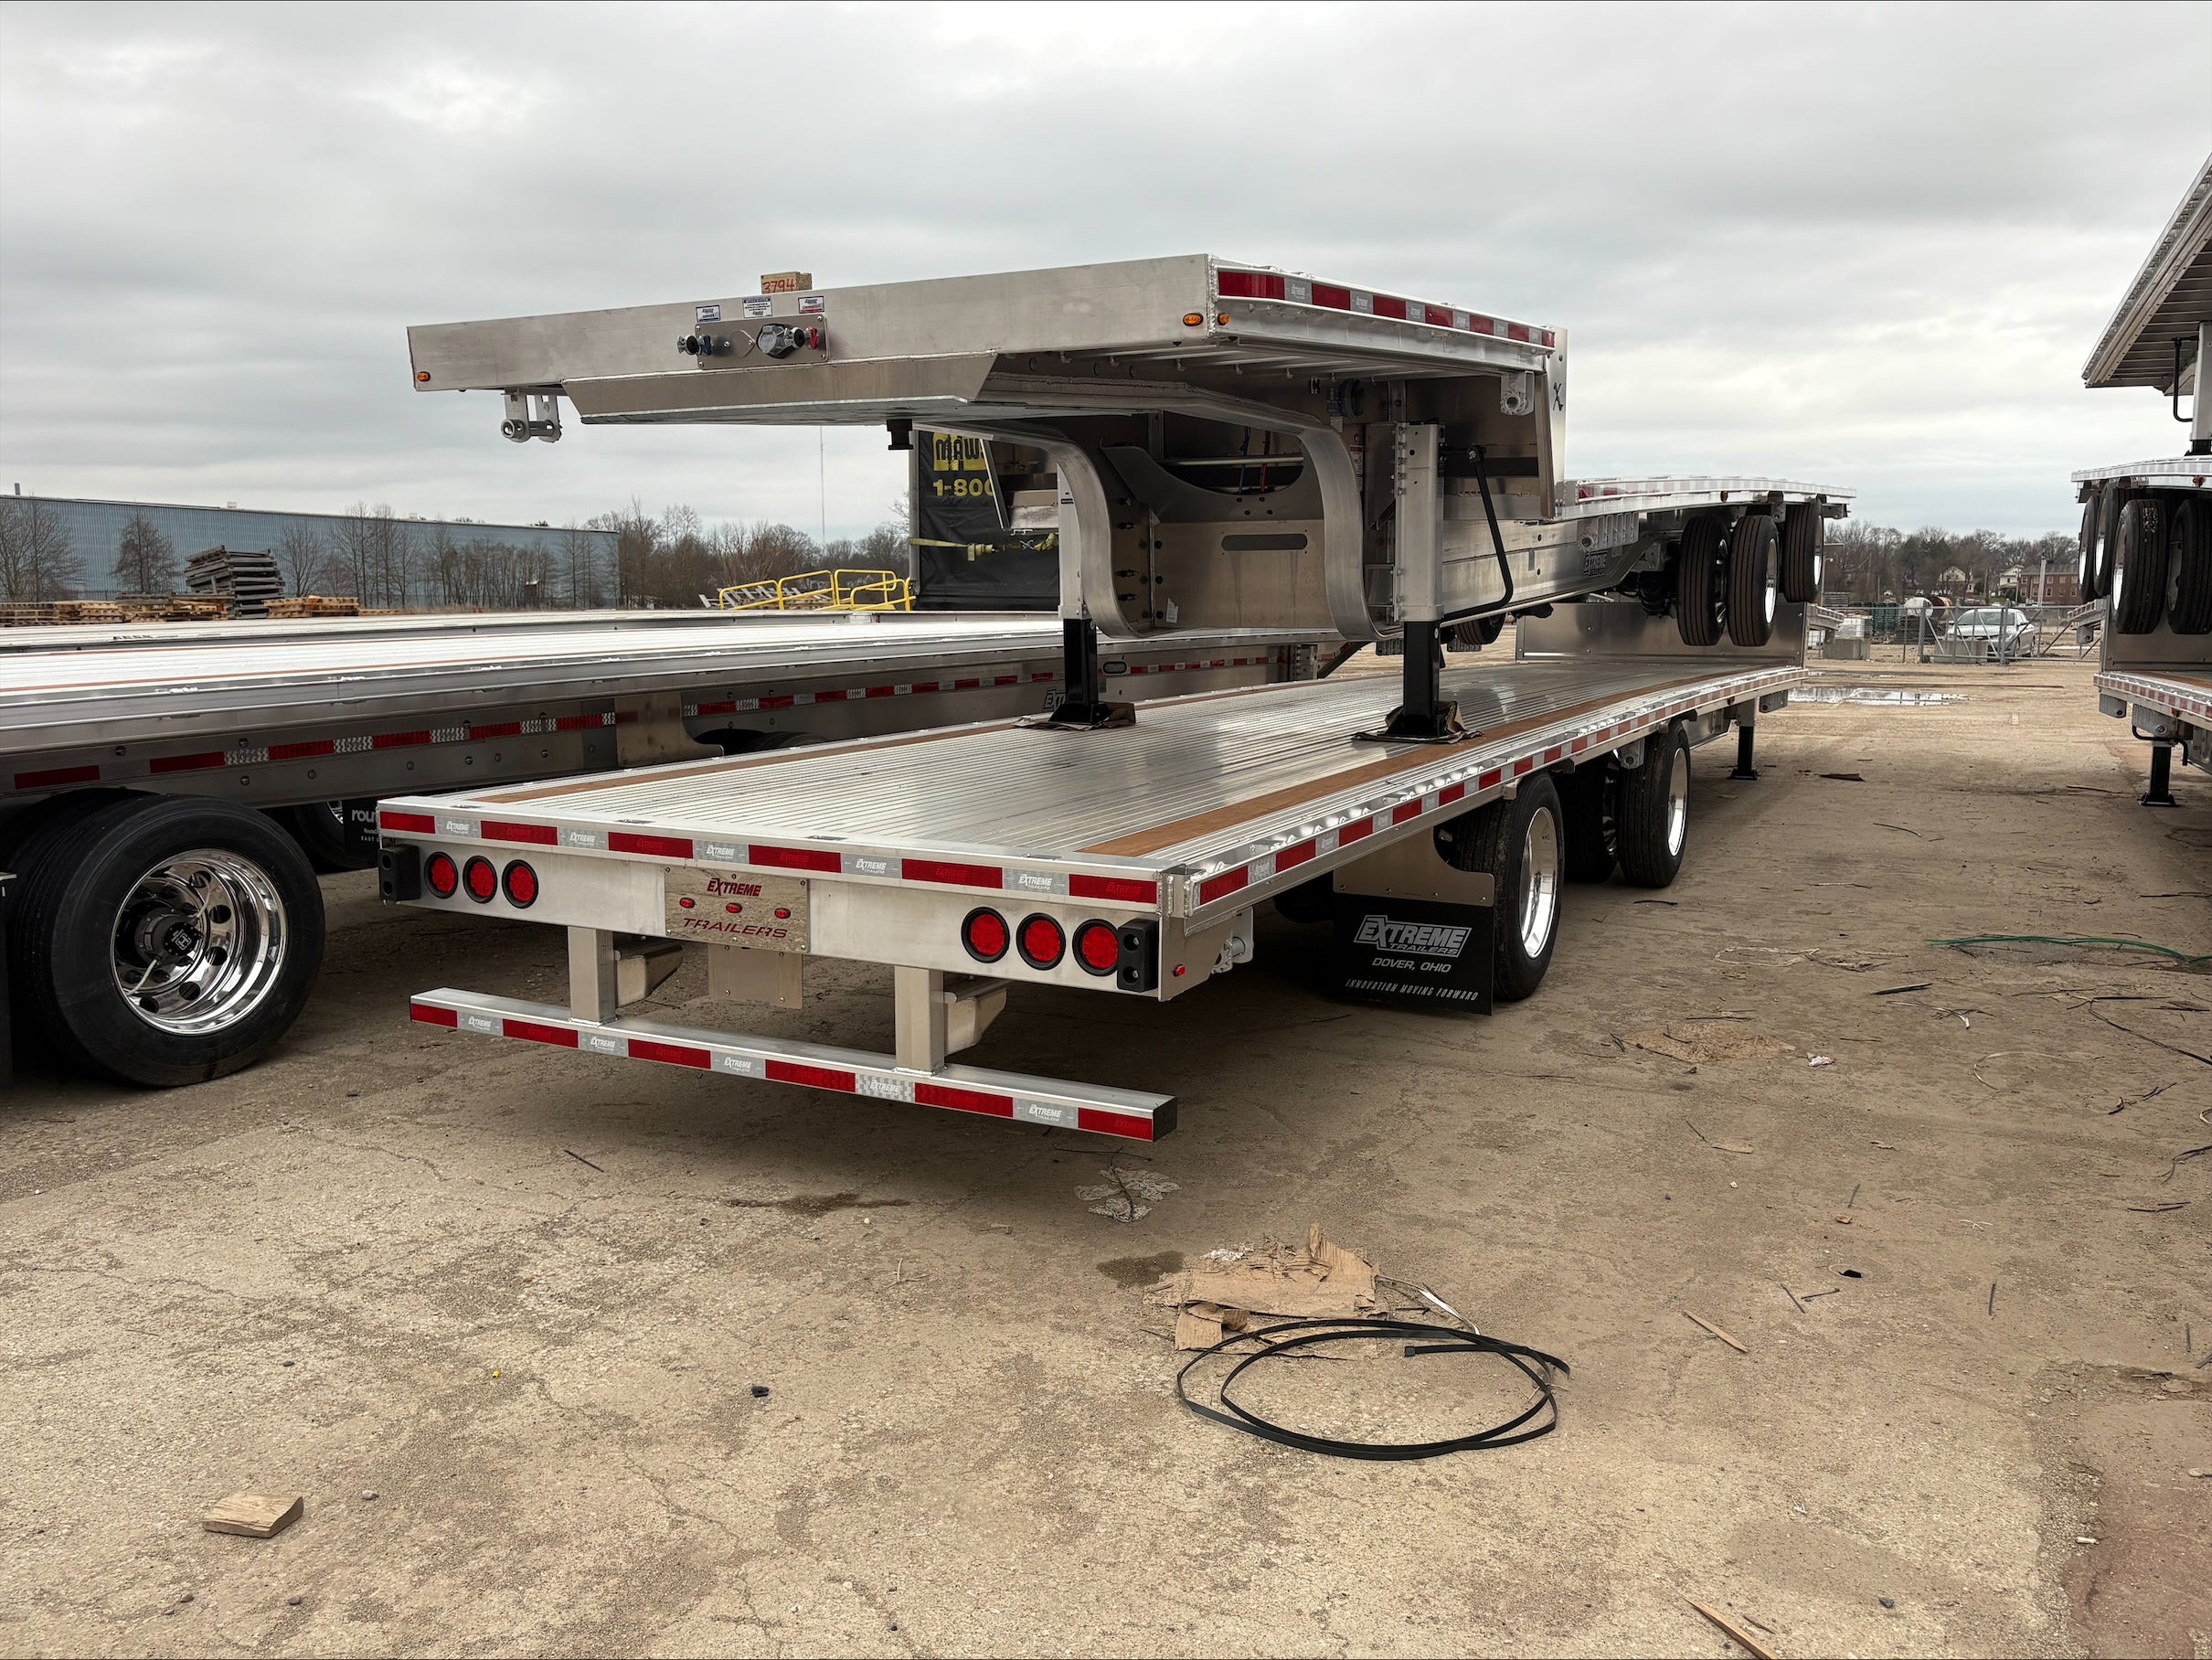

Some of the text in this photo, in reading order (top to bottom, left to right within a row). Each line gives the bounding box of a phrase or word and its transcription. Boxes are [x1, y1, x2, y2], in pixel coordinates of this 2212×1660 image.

[762, 278, 795, 293] 3794
[935, 437, 984, 461] MAW
[569, 832, 596, 843] EXTREME
[706, 844, 735, 857] EXTREME
[856, 858, 887, 870] EXTREME
[1018, 874, 1053, 886] EXTREME
[706, 878, 762, 897] EXTREME
[1106, 882, 1142, 895] EXTREME
[683, 918, 788, 938] TRAILERS
[1358, 917, 1467, 949] EXTREME
[1389, 942, 1459, 955] TRAILERS
[1371, 957, 1452, 973] DOVER, OHIO
[1345, 978, 1479, 1001] INNOVATION MOVING FORWARD
[590, 1036, 616, 1048] EXTREME
[724, 1056, 752, 1069] EXTREME
[869, 1080, 900, 1092] EXTREME
[1028, 1103, 1062, 1117] EXTREME
